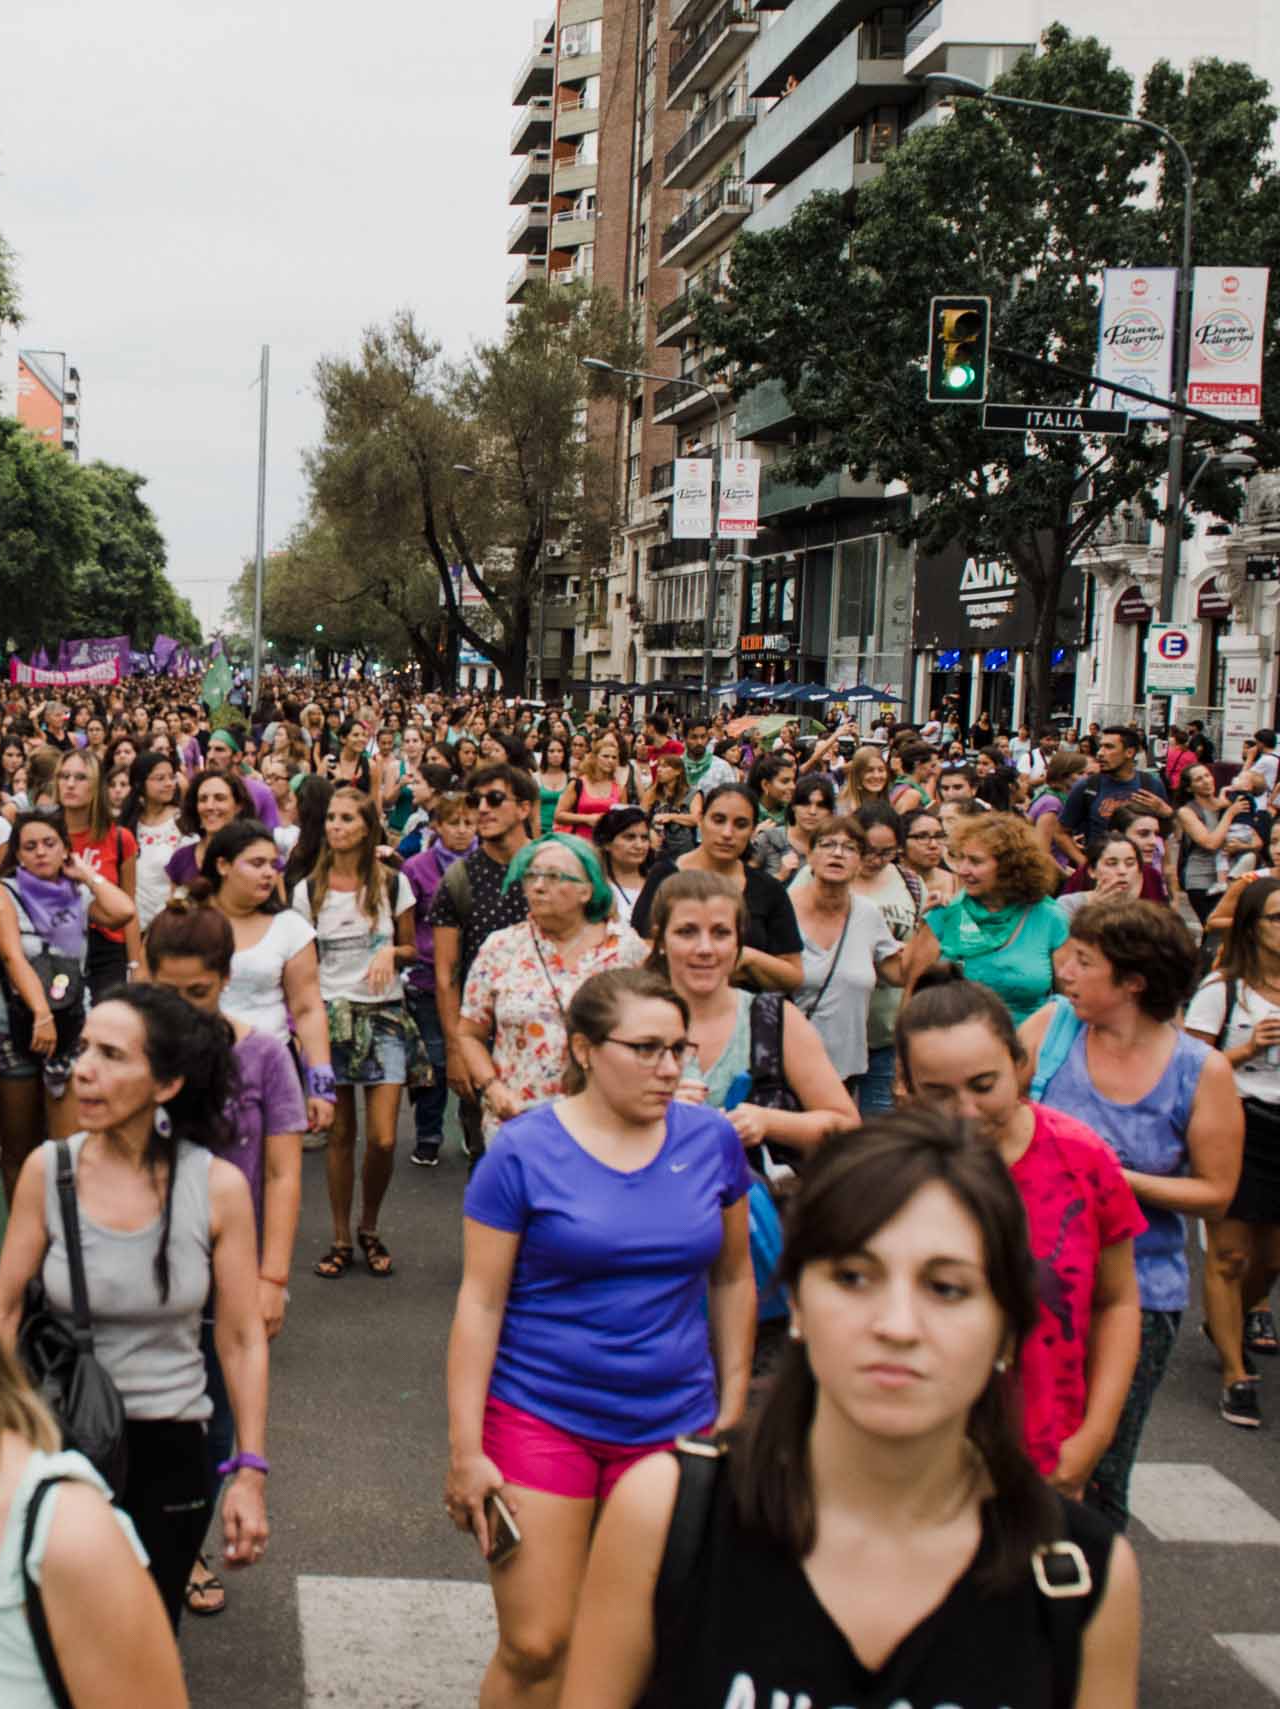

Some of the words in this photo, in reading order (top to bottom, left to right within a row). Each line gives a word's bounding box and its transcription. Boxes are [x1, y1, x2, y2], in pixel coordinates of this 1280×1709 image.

[1192, 386, 1257, 404] Esencial
[1026, 411, 1084, 429] ITALIA
[1165, 635, 1185, 656] E
